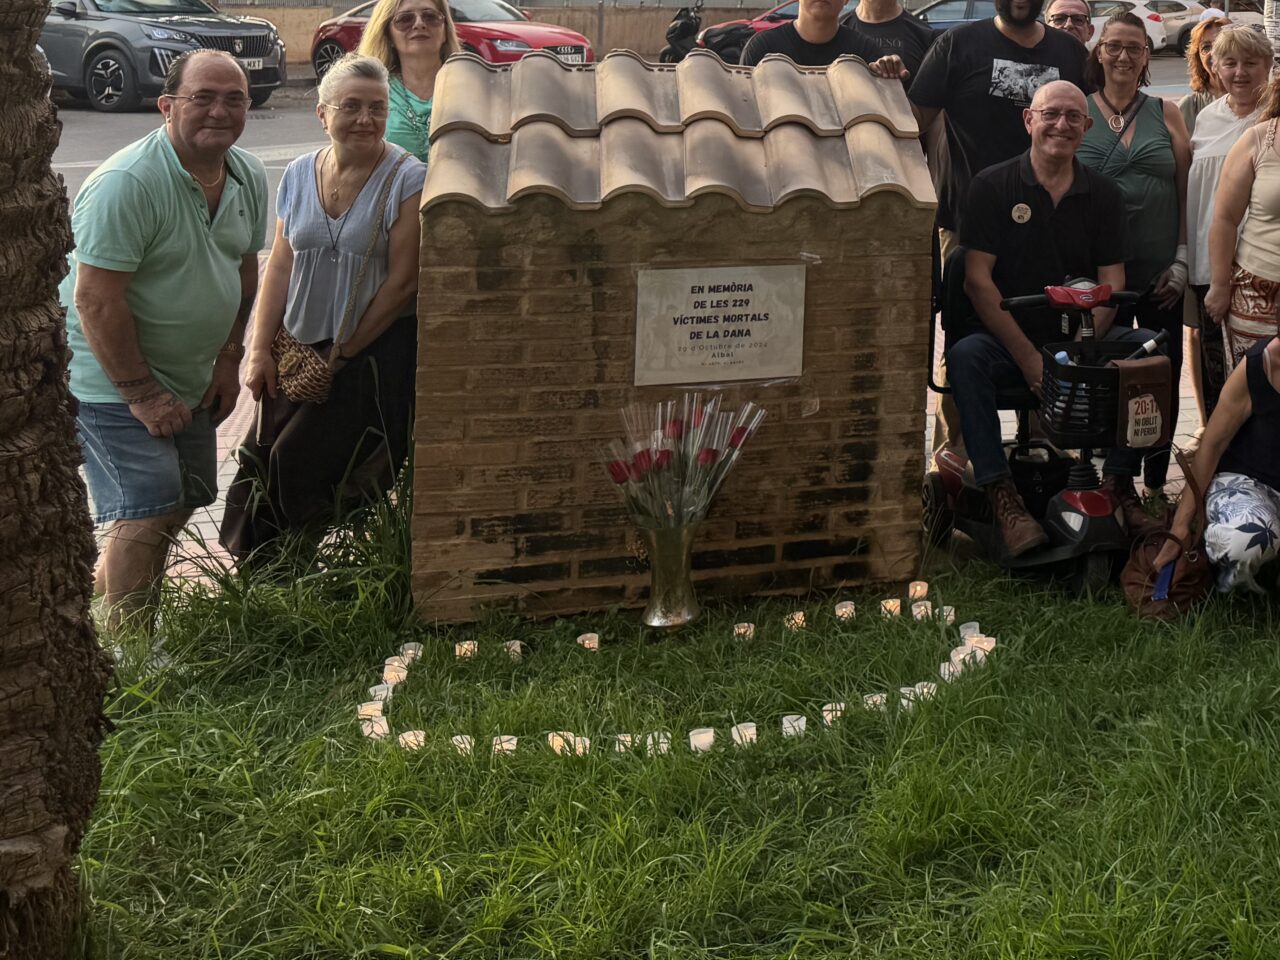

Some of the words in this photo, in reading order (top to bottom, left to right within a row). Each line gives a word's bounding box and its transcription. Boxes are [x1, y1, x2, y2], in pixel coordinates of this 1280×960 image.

[691, 285, 704, 294] EN
[708, 282, 753, 294] MEMÒRIA
[693, 300, 707, 309] DE
[710, 299, 729, 309] LES
[732, 298, 750, 308] 229
[673, 315, 719, 325] VÍCTIMES
[722, 313, 769, 323] MORTALS
[689, 331, 703, 340] DE
[706, 330, 719, 339] LA
[723, 328, 751, 338] DANA
[1134, 418, 1141, 427] NI
[1142, 416, 1158, 426] OBLIT
[1134, 428, 1141, 437] NI
